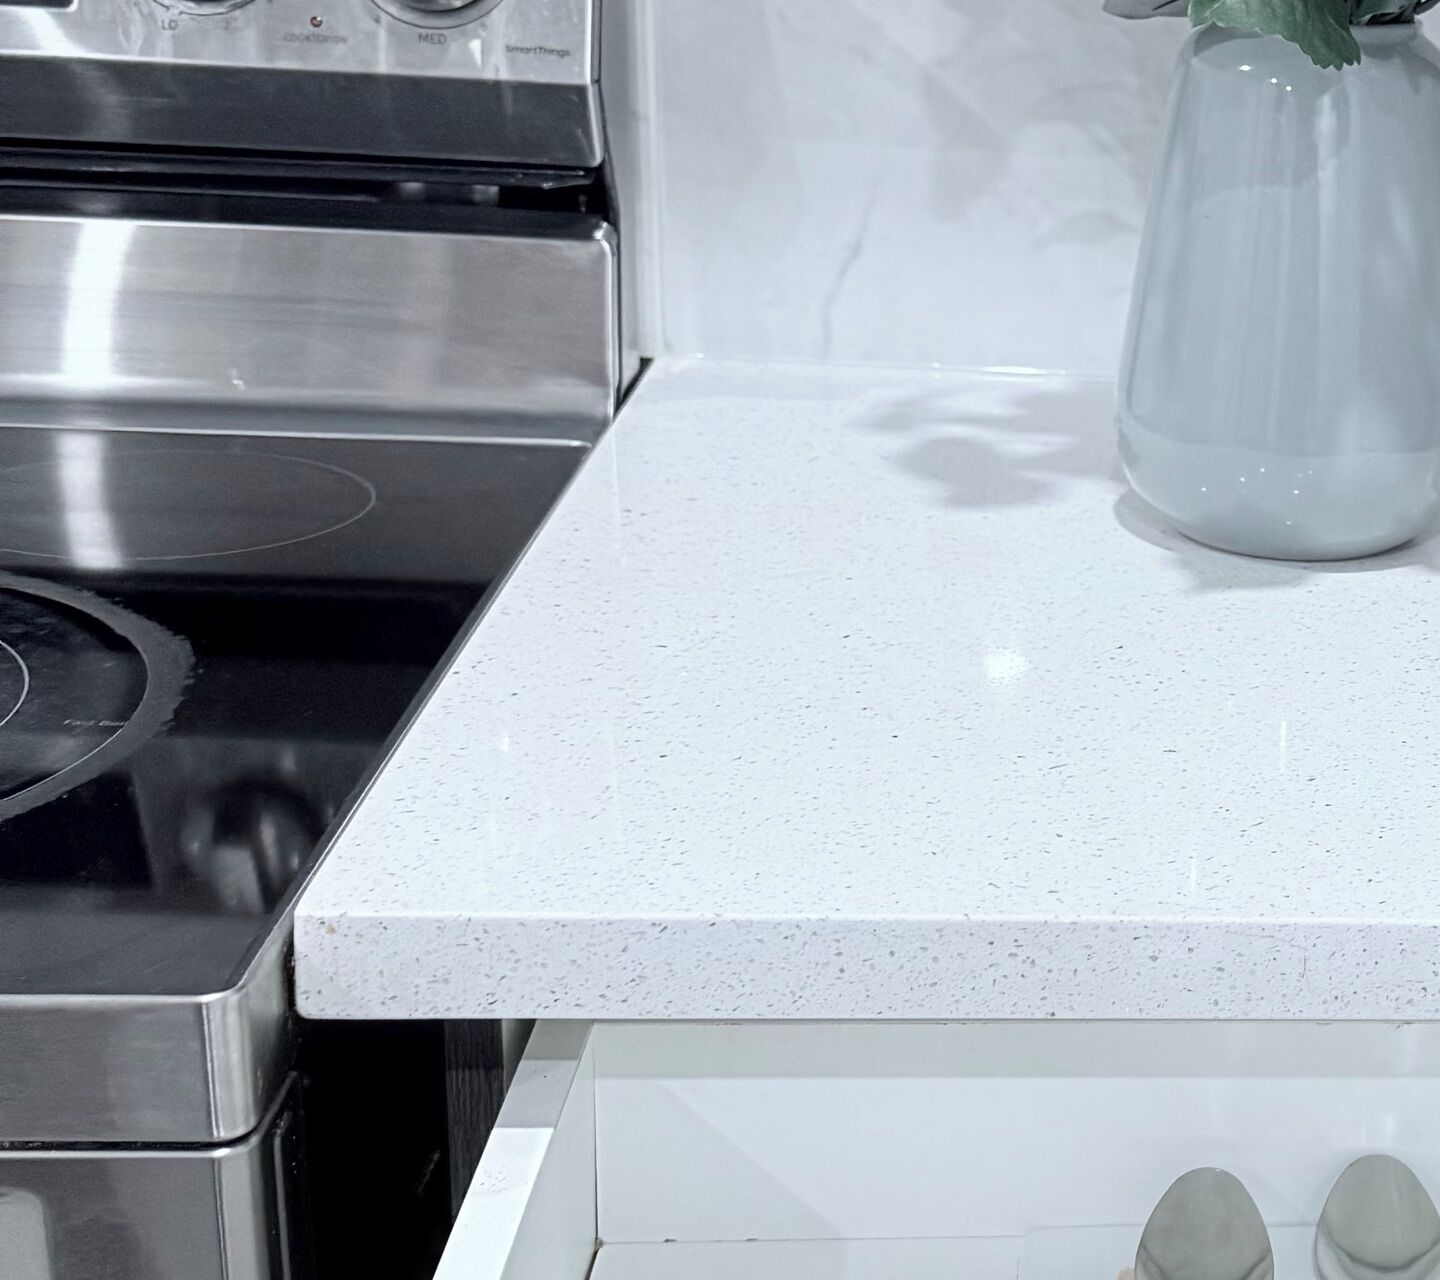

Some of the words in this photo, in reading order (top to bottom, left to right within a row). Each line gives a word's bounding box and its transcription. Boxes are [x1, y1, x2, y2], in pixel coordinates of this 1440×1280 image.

[161, 19, 179, 30] LO
[418, 33, 447, 45] MED
[505, 44, 571, 58] SmartThings
